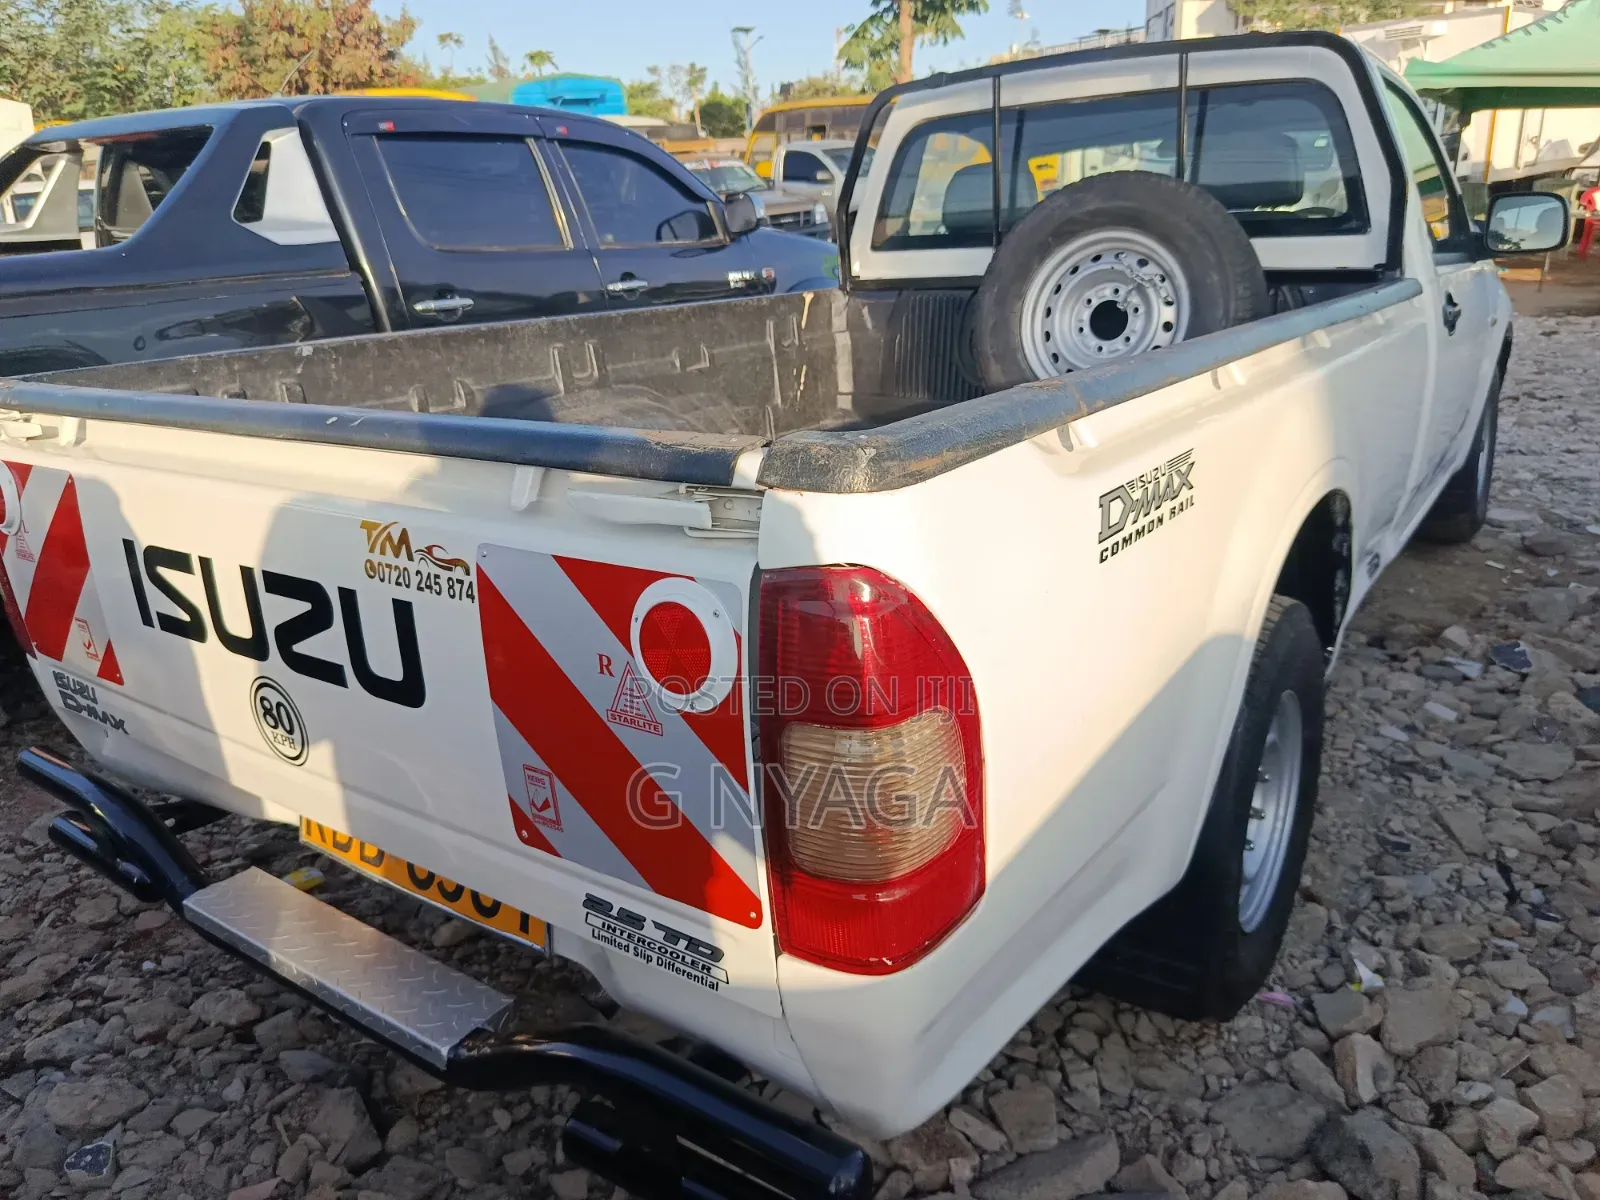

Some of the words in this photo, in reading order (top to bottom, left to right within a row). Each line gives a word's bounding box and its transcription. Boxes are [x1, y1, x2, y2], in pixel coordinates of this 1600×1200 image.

[1135, 463, 1167, 491] ISUZU
[1099, 513, 1164, 564] COMMON
[1169, 495, 1194, 520] RAIL
[377, 561, 411, 589] 0720
[415, 570, 442, 596] 245
[447, 577, 475, 603] 874
[122, 538, 426, 709] ISUZU
[597, 653, 615, 678] R
[52, 670, 98, 705] ISUZU
[259, 695, 295, 736] 80
[610, 713, 660, 733] STARLITE
[591, 927, 631, 954] Limited
[633, 945, 654, 965] Slip
[656, 958, 720, 992] Differential
[601, 920, 713, 975] INTERCOOLER
[651, 919, 726, 963] TD
